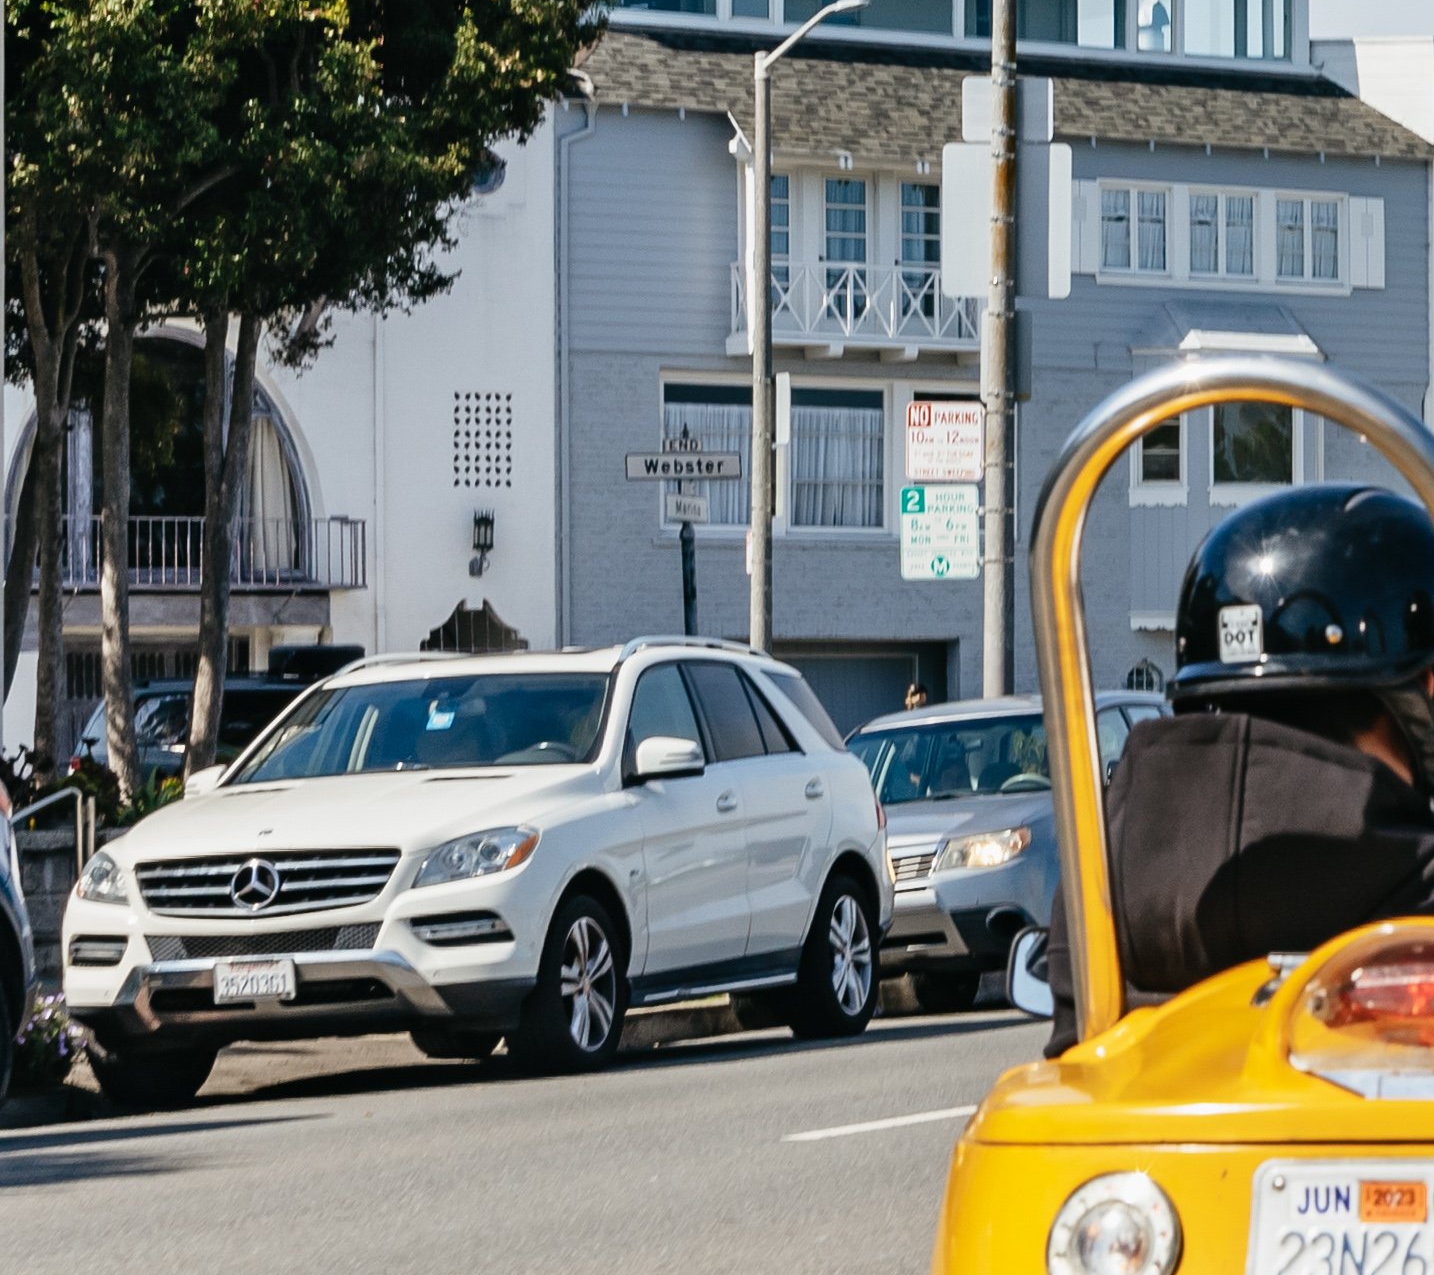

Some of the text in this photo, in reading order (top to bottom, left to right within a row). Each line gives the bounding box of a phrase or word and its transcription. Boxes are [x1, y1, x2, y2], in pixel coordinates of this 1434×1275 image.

[910, 405, 979, 426] NO PARKING
[667, 438, 699, 452] END
[644, 458, 725, 476] Webster
[906, 490, 920, 512] 2
[936, 492, 965, 502] HOUR
[927, 503, 975, 515] PARKING
[910, 534, 932, 545] MON
[954, 533, 970, 544] FRI
[1225, 630, 1254, 644] DOT
[1298, 1186, 1350, 1214] JUN
[1373, 1189, 1416, 1206] 2023
